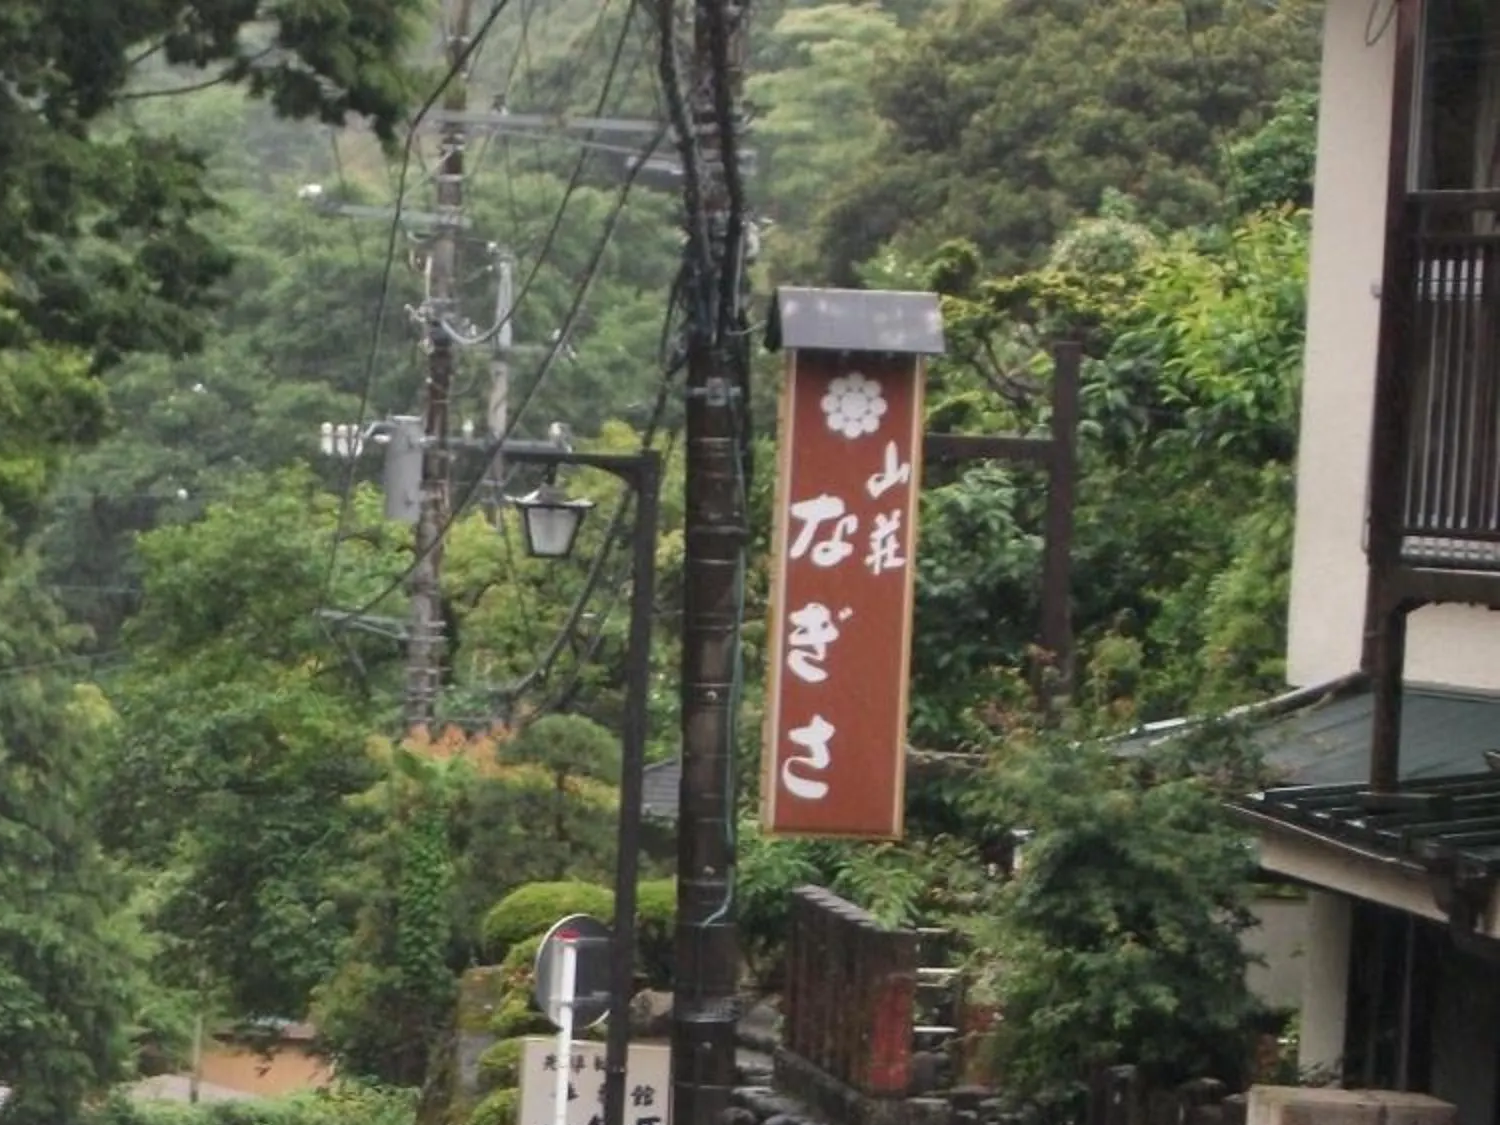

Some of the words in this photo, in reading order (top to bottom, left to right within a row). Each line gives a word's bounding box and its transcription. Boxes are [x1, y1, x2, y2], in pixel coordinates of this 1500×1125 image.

[864, 440, 911, 576] 山荘
[781, 493, 859, 800] なぎさ
